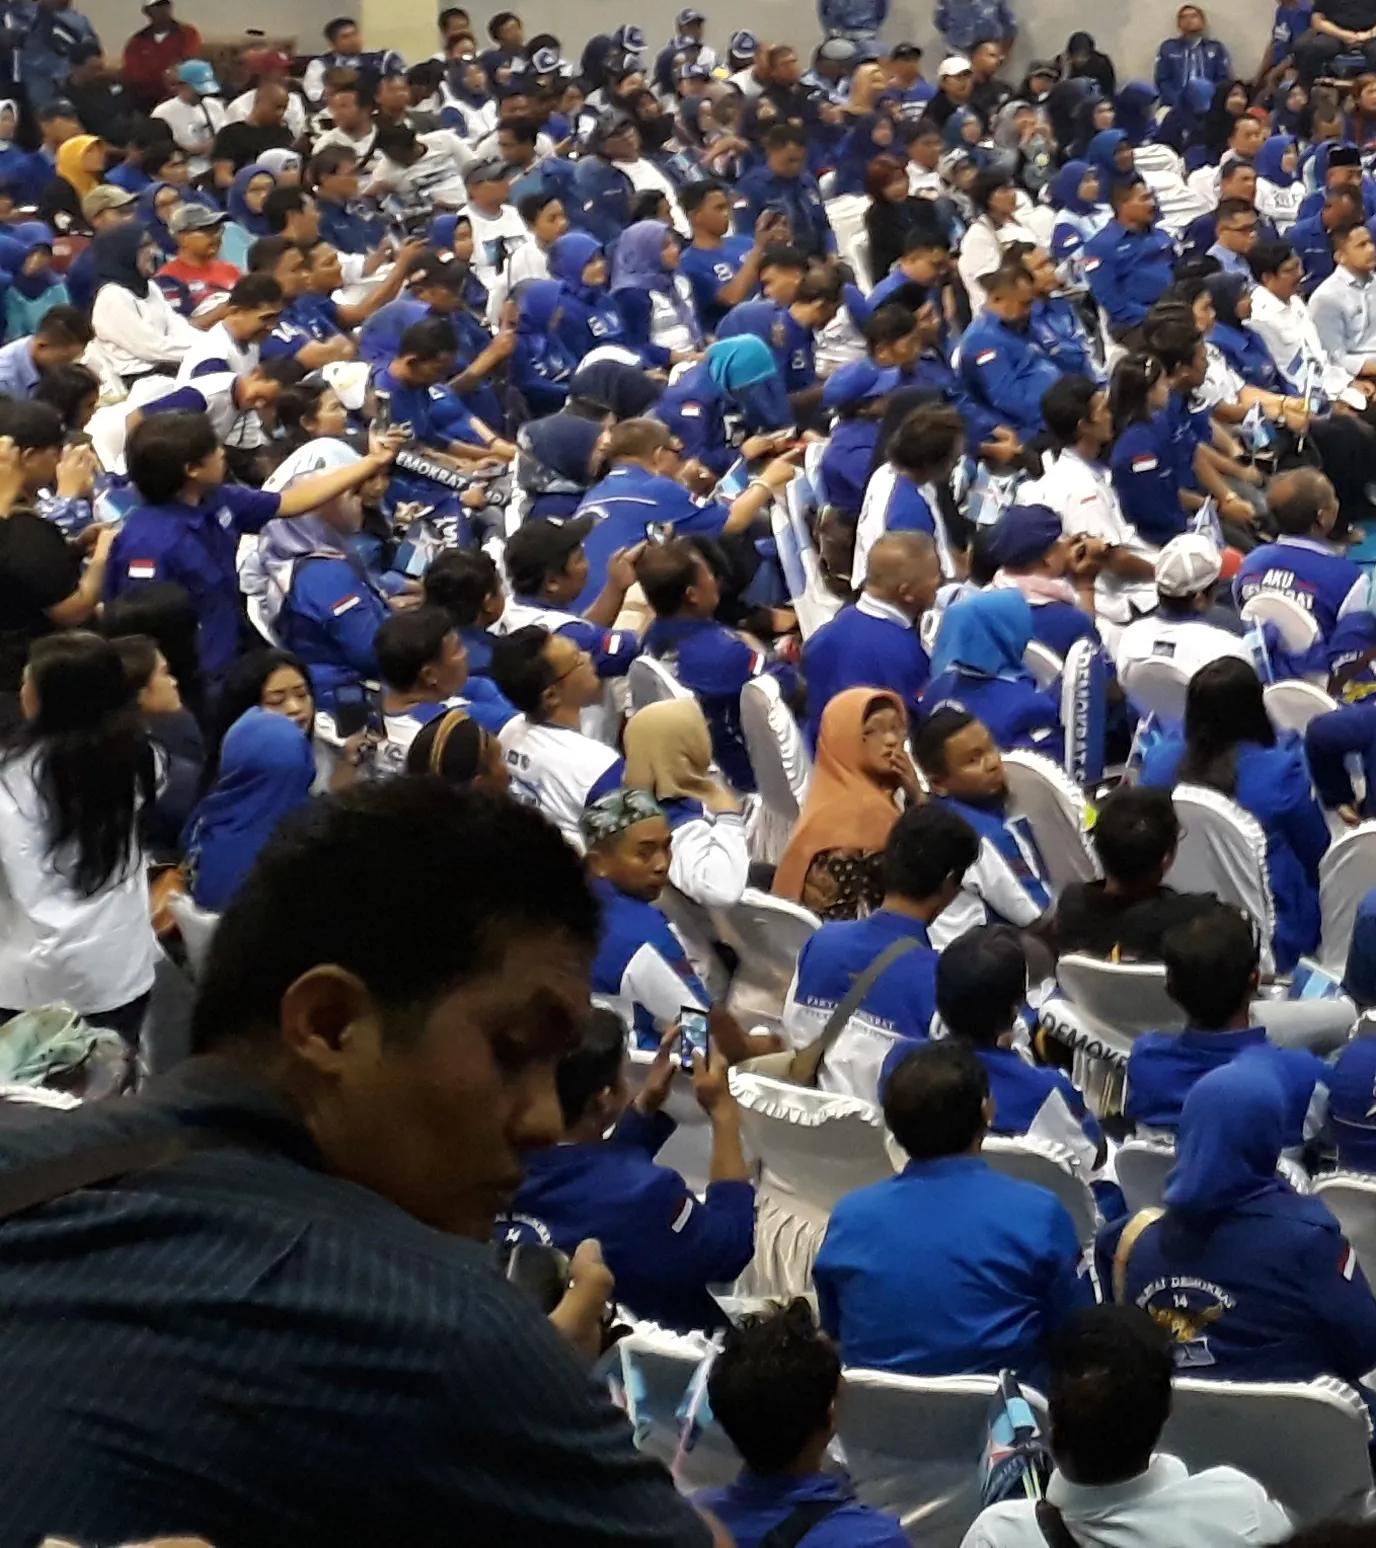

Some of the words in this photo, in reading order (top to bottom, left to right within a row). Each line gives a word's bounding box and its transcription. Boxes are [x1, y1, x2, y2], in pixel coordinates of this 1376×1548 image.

[395, 450, 468, 490] EMOKRAT
[1261, 567, 1296, 589] AKU
[1041, 1011, 1130, 1069] DEMOKR
[1172, 1293, 1189, 1309] 14
